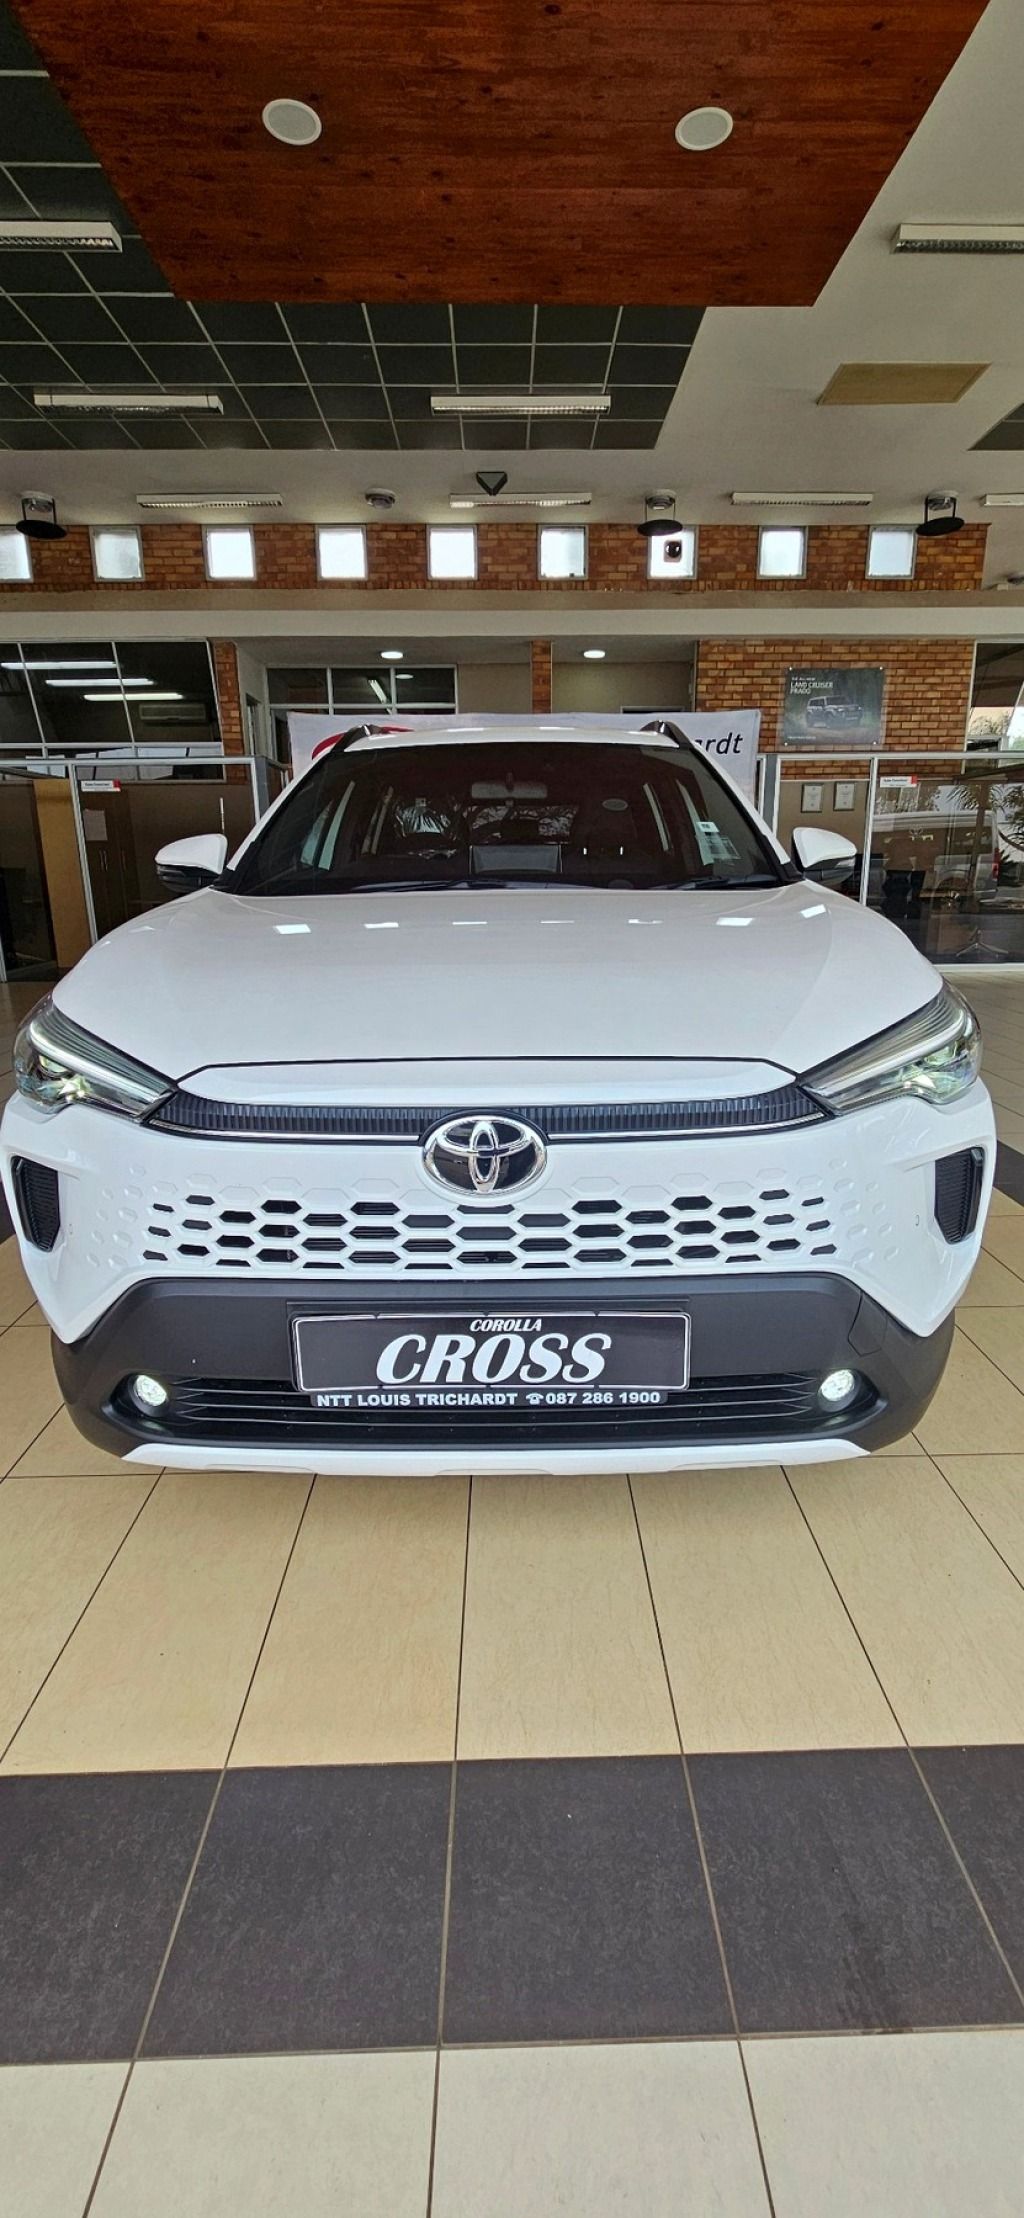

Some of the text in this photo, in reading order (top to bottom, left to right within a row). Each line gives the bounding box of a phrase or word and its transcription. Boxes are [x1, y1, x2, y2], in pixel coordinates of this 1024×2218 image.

[470, 1319, 542, 1332] COROLLA
[376, 1333, 612, 1384] CROSS
[317, 1391, 661, 1407] NTT LOUIS TRICHARDT 087 286 1900
